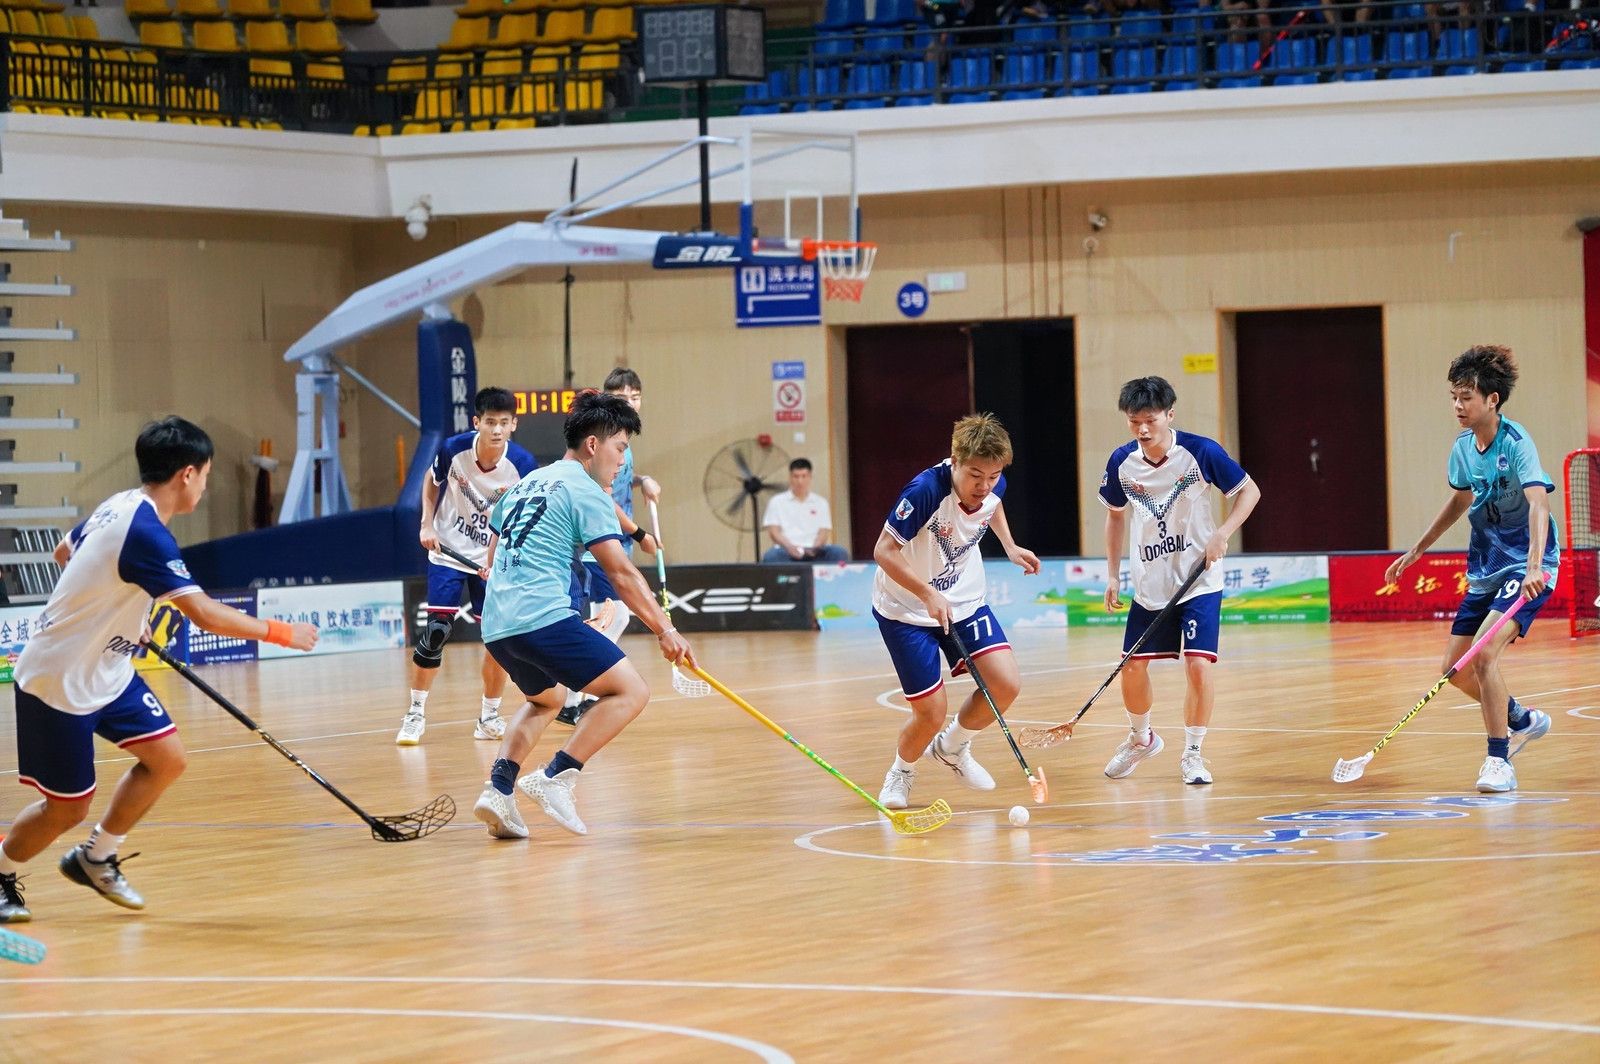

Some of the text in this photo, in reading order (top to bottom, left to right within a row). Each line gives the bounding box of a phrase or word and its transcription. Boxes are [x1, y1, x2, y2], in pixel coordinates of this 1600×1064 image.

[900, 292, 925, 308] 3号
[453, 515, 493, 548] FLOORB
[471, 513, 488, 529] 29
[500, 496, 548, 551] 47
[1157, 520, 1168, 539] 3
[1138, 534, 1193, 562] LOORBALL
[966, 615, 993, 641] 77
[1186, 619, 1198, 640] 3
[142, 692, 164, 717] 9
